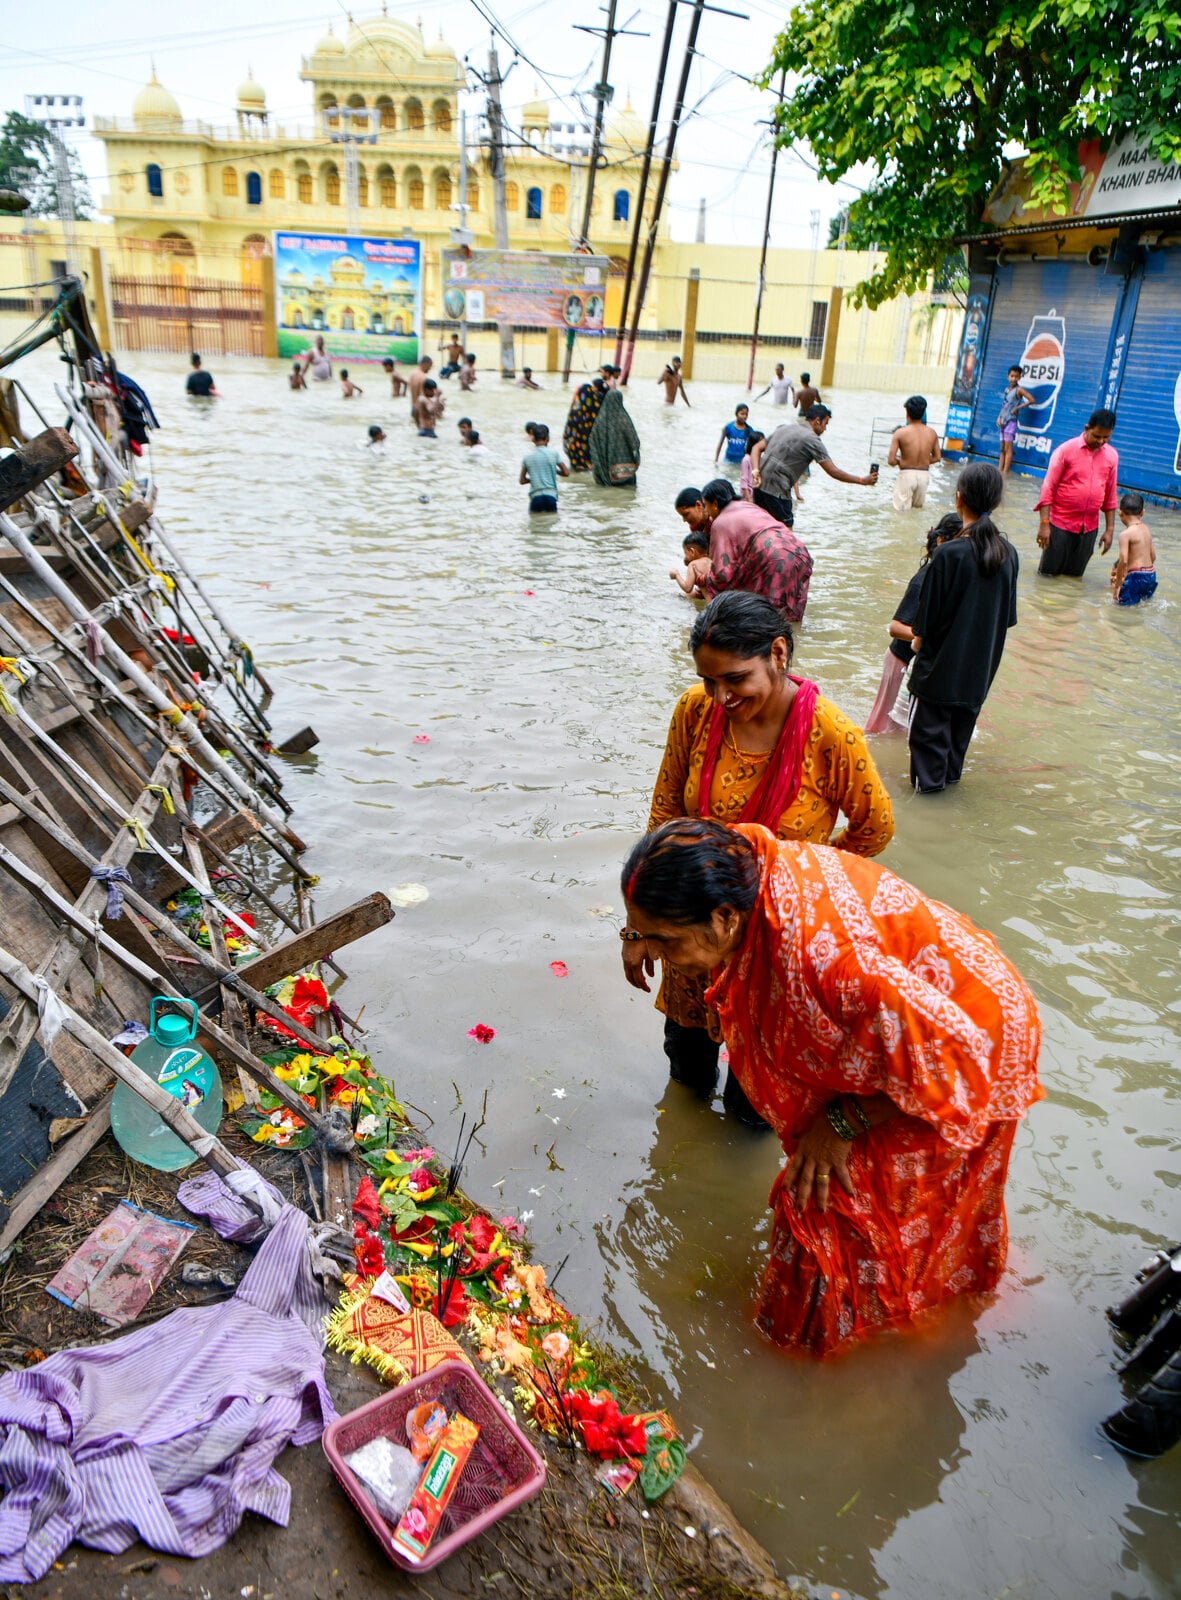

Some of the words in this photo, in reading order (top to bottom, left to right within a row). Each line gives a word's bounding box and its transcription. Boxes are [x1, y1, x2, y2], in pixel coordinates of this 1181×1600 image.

[1118, 147, 1148, 168] MAA
[1098, 170, 1145, 193] KHAINI
[1021, 363, 1059, 380] PEPSI
